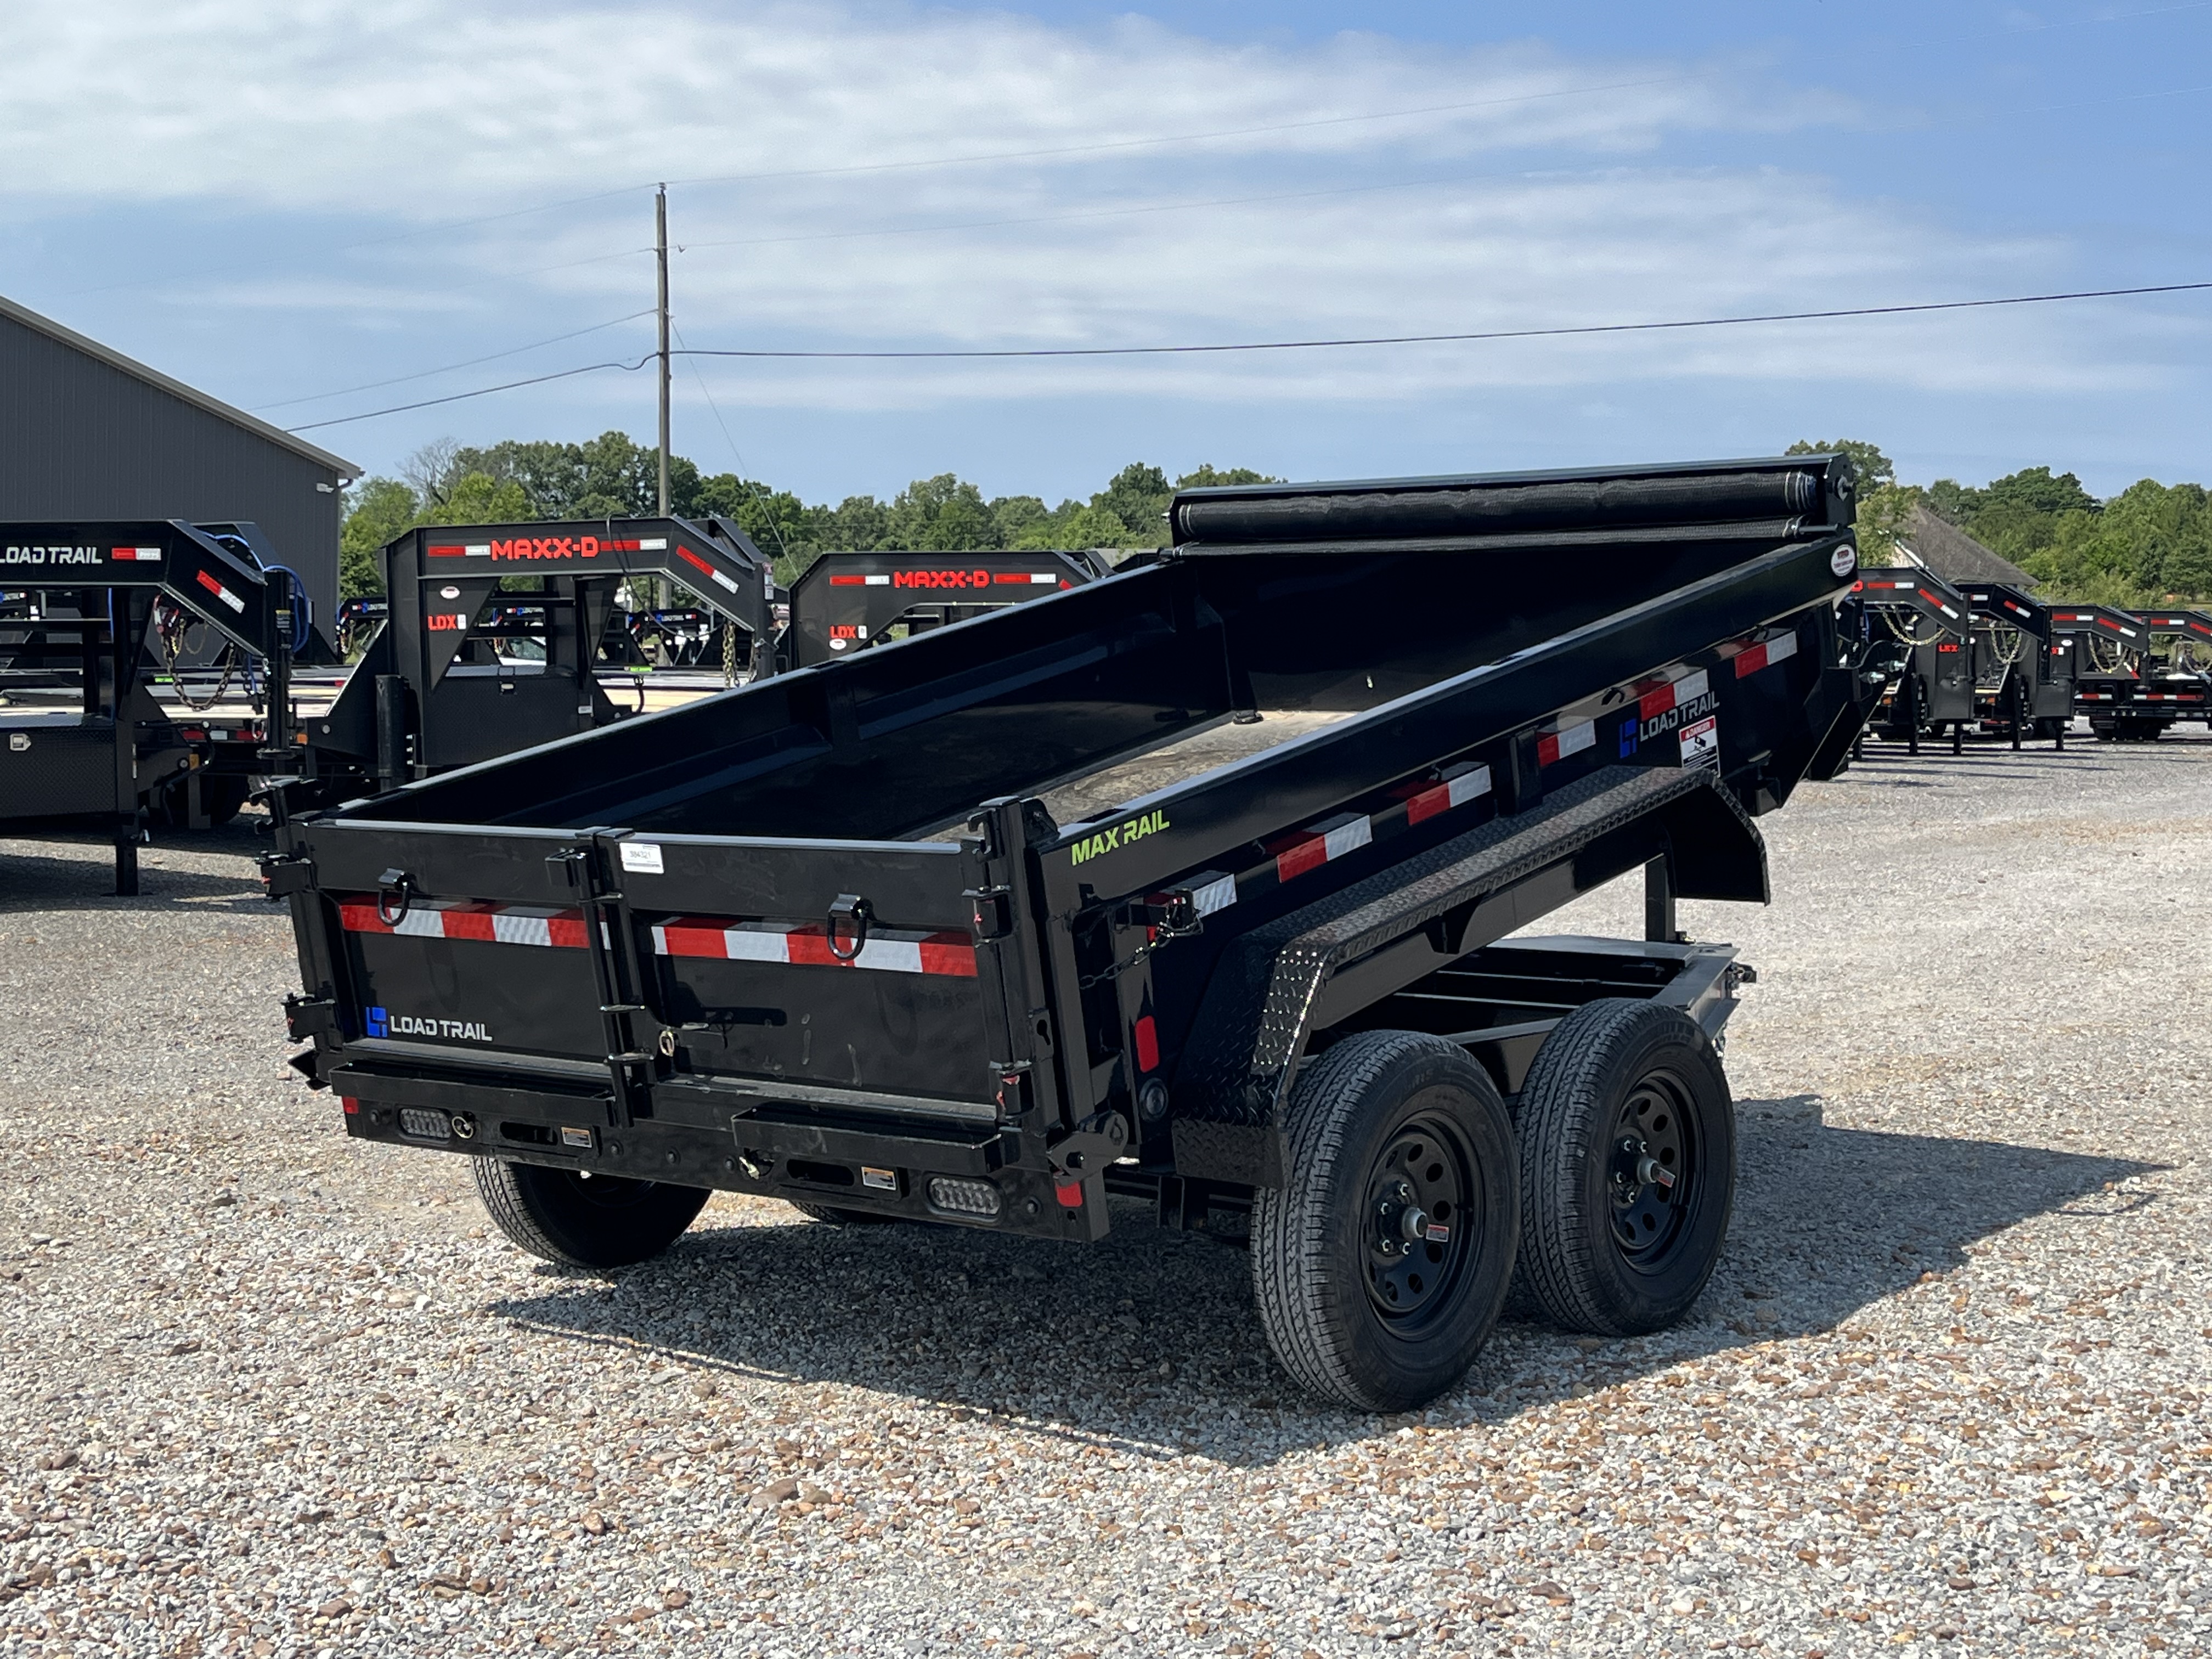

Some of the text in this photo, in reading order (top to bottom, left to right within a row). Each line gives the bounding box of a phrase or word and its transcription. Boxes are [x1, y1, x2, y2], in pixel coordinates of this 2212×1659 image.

[48, 547, 103, 564] TRAIL
[491, 536, 599, 561] MAXX-D
[893, 570, 990, 589] MAXX-D
[428, 614, 456, 631] LDX
[830, 624, 856, 639] LDX
[1640, 691, 1720, 742] LOAD TRAIL
[1071, 809, 1170, 866] MAX RAIL
[390, 1015, 493, 1041] LOAD TRAIL
